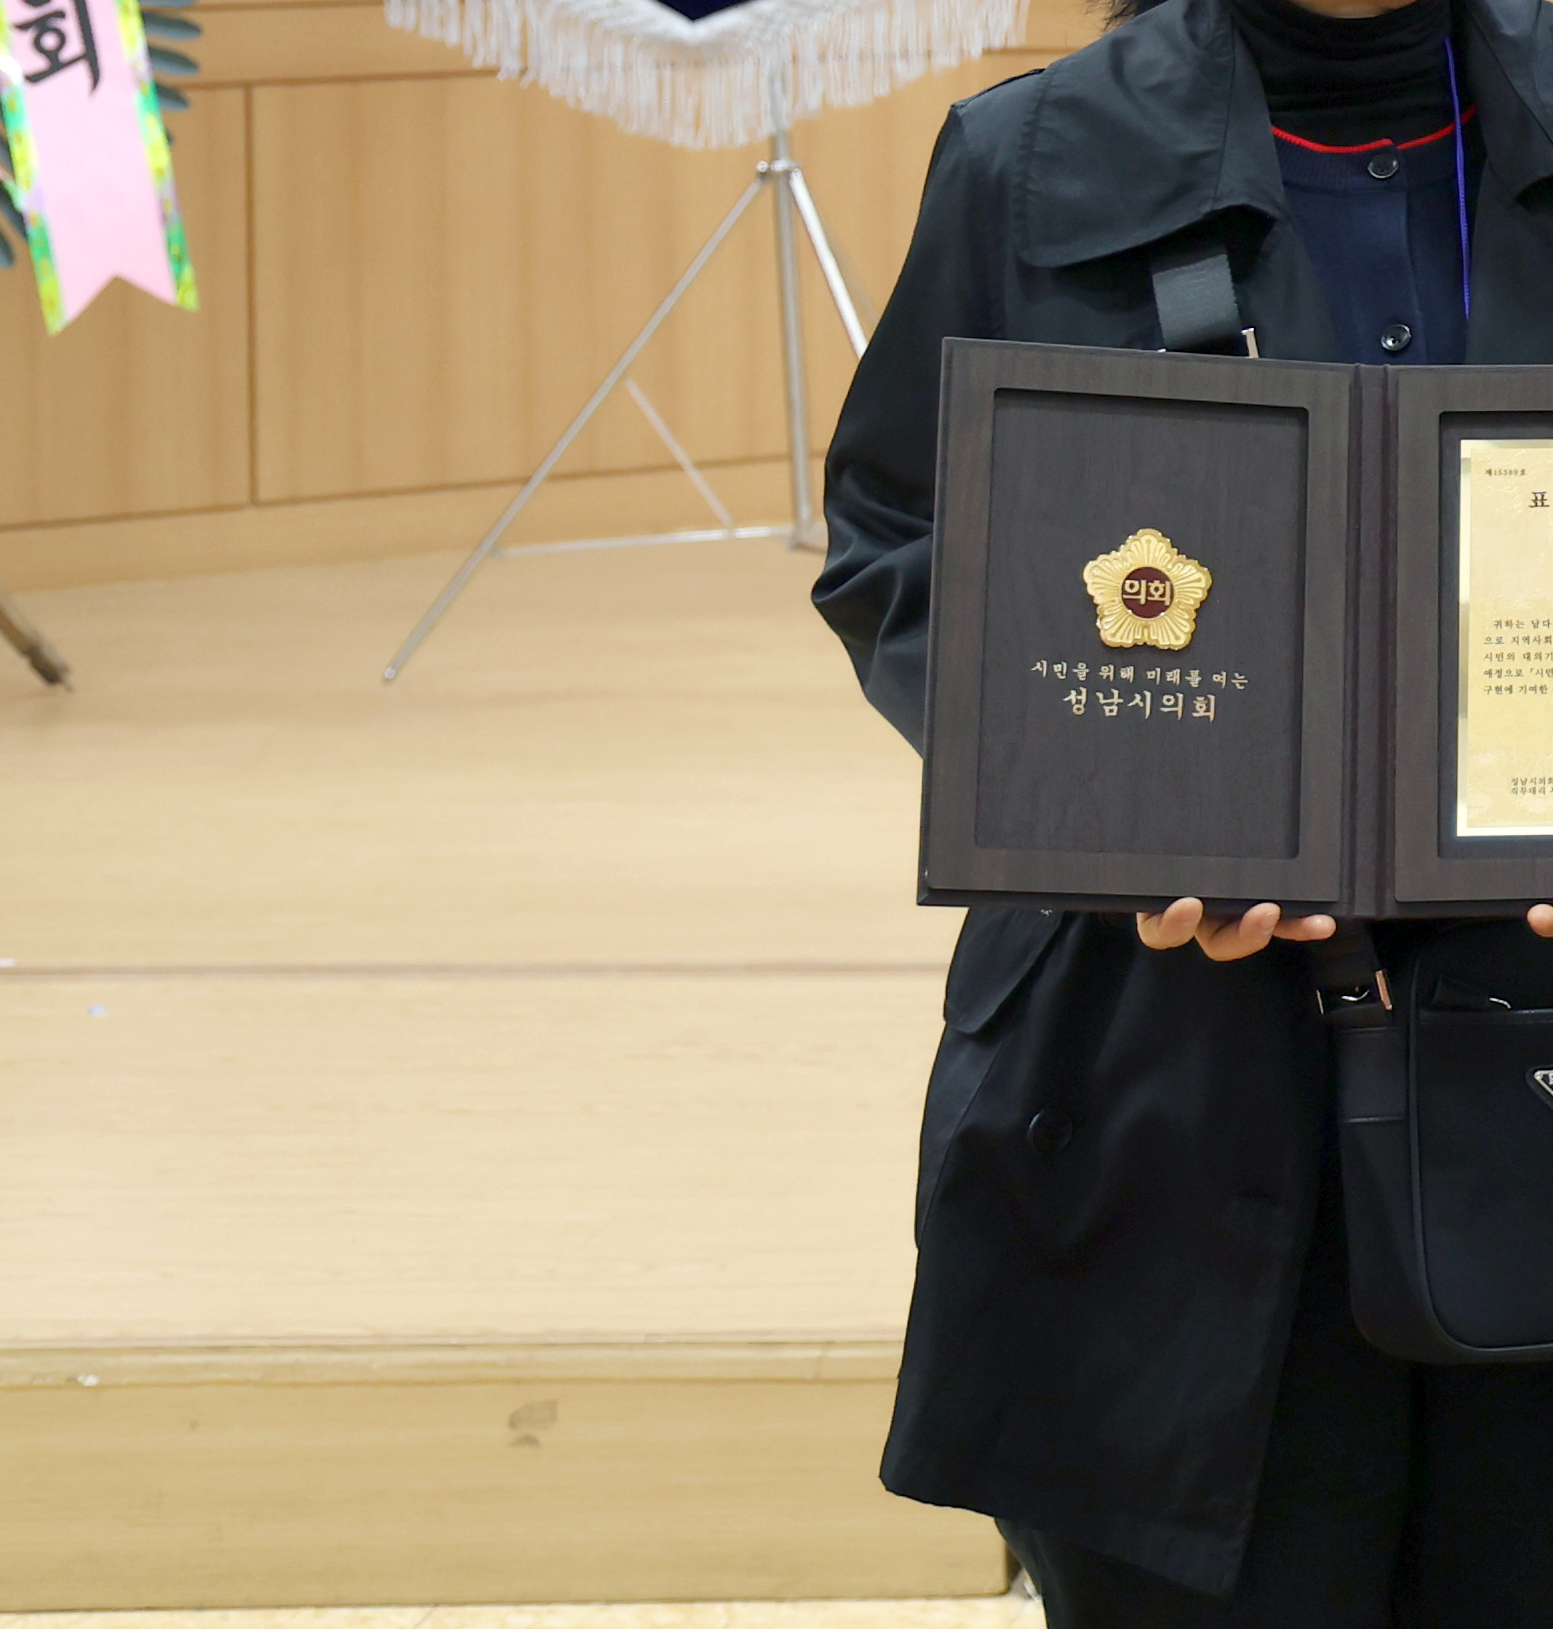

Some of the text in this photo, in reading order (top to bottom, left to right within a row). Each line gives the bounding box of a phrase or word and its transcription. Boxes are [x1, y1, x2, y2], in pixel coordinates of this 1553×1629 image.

[1122, 579, 1171, 605] 의회
[1031, 660, 1090, 681] 시민을
[1098, 664, 1134, 683] 위해
[1146, 667, 1202, 688] 미래를
[1063, 686, 1217, 722] 성남시의회
